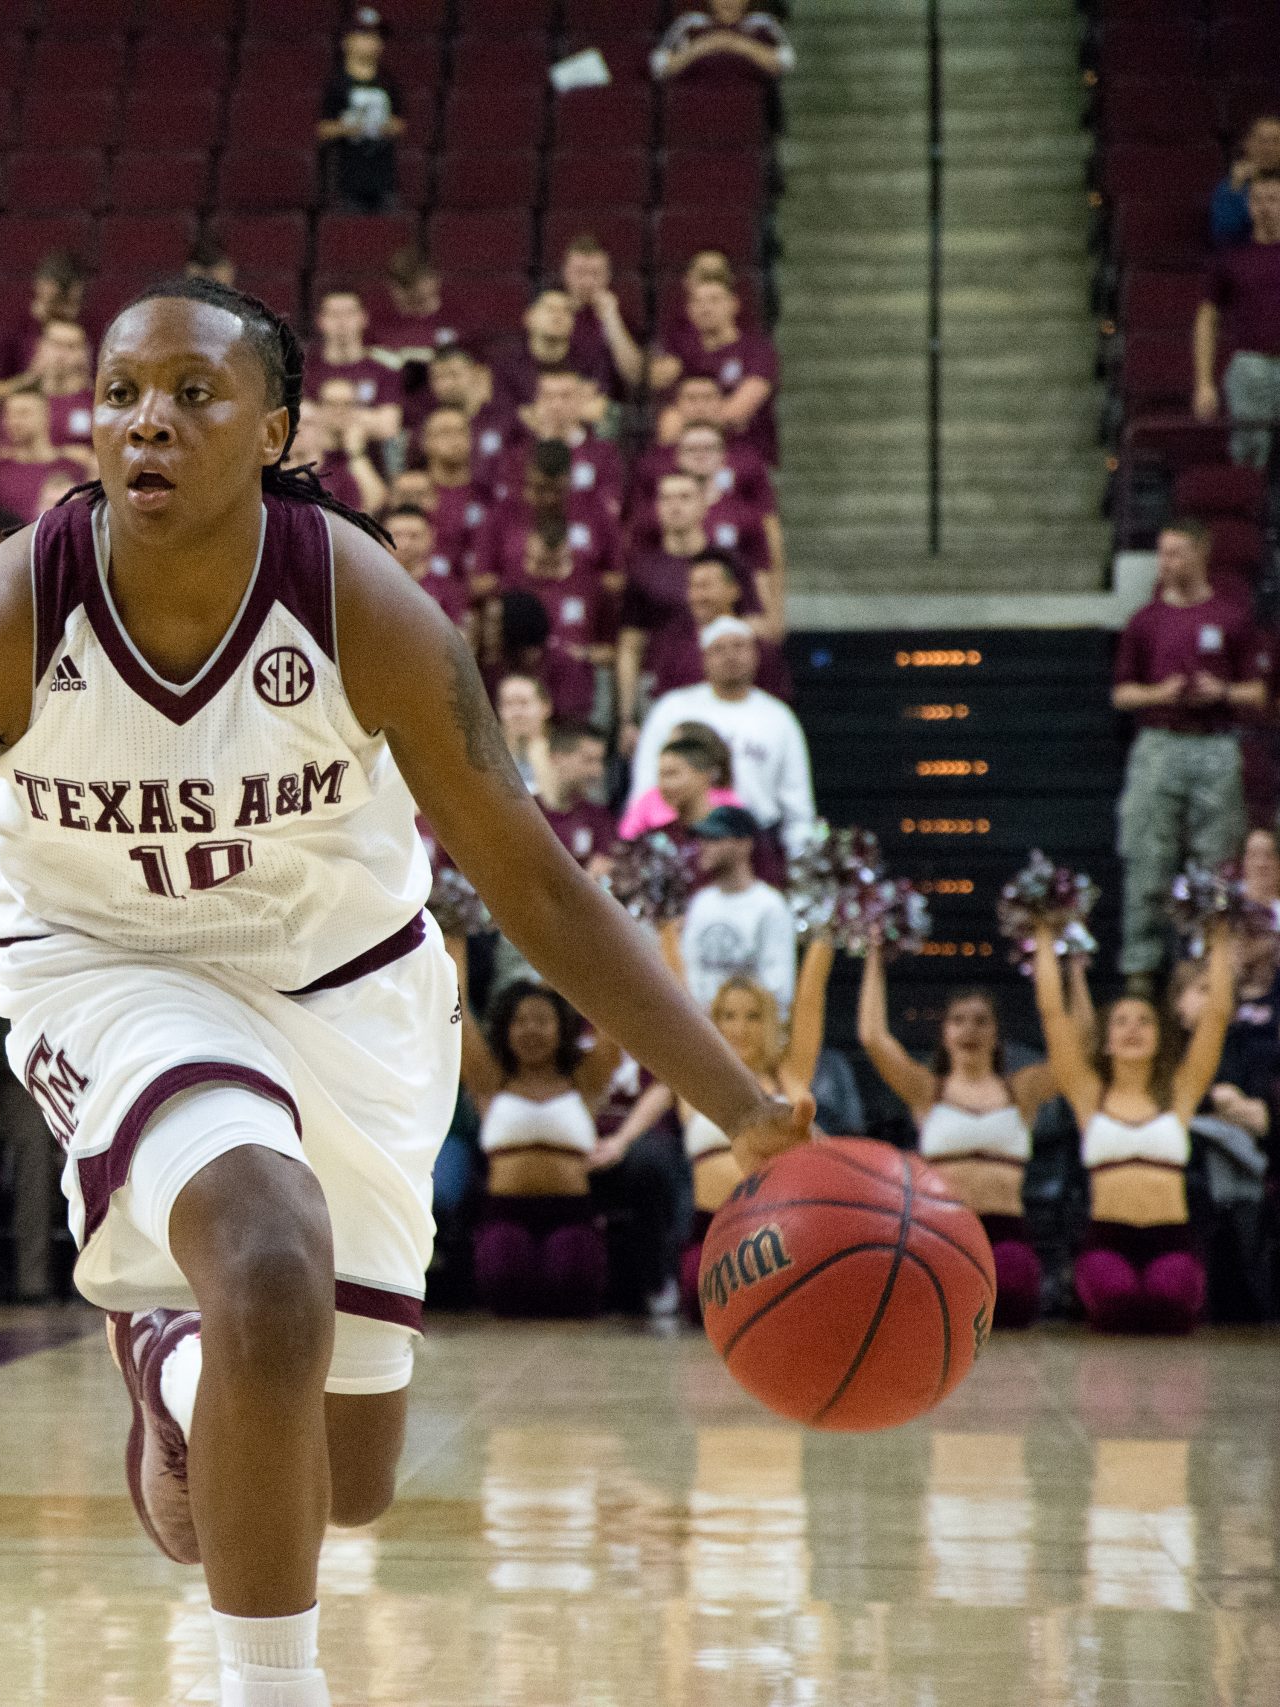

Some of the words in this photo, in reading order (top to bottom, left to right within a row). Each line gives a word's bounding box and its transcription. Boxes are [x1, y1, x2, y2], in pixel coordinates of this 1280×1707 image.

[260, 651, 310, 702] SEC
[14, 769, 217, 833] TEXAS
[235, 760, 349, 828] A&M
[128, 839, 253, 899] 10
